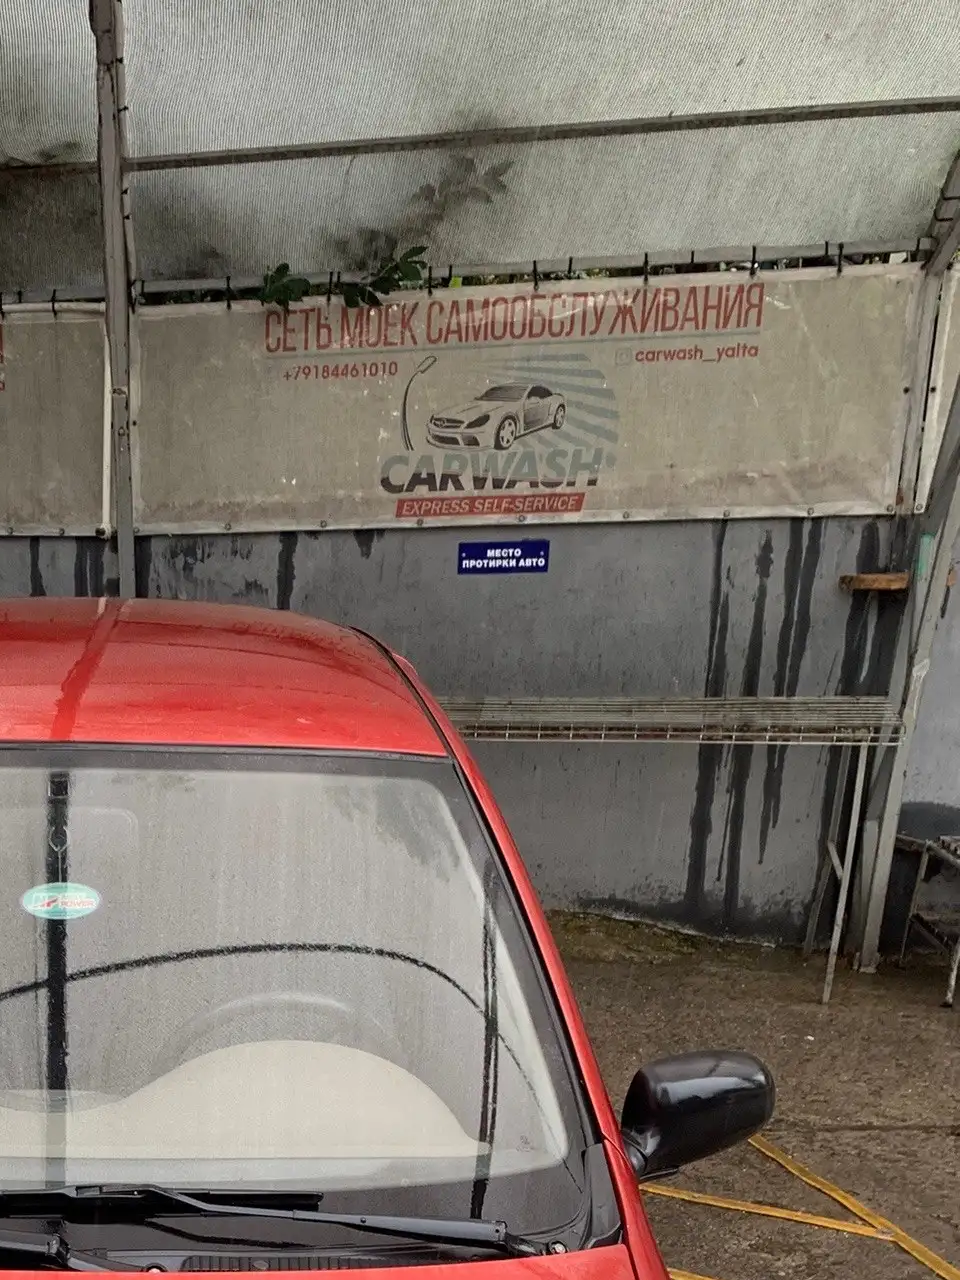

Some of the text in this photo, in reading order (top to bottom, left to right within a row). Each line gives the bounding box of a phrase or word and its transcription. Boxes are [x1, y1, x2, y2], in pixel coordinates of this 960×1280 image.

[265, 282, 765, 353] СЕТЬ МОЕК САМООБСЛУЖИВАНИЯ
[635, 342, 759, 364] carwash_yalta
[283, 361, 398, 381] +79184461010
[380, 447, 603, 494] CARWASH
[402, 495, 578, 515] EXPRESS SELF-SERVICE
[462, 557, 545, 568] ПРОТИРКИ АВТО
[487, 548, 522, 557] МЕСТО
